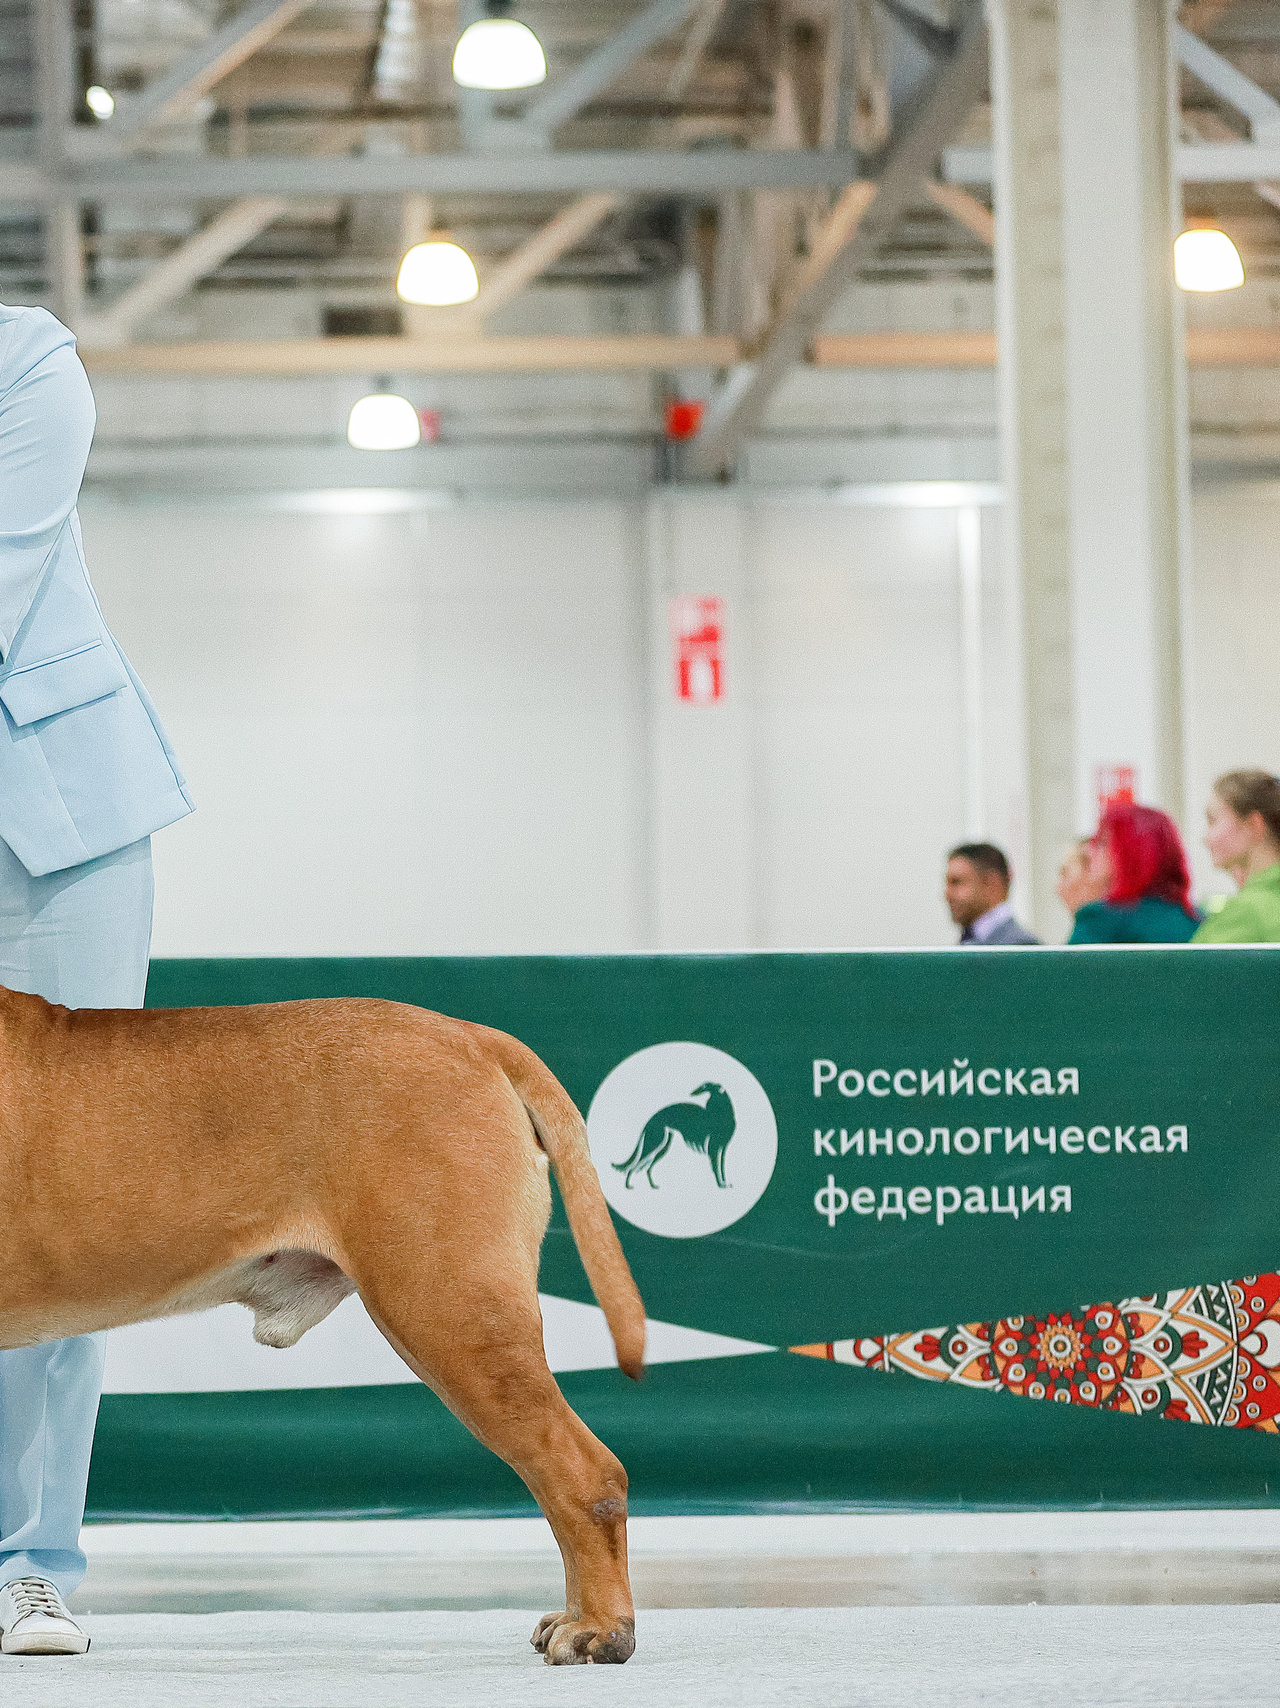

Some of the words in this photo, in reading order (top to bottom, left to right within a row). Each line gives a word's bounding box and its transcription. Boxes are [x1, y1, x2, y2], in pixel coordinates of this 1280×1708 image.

[812, 1058, 1080, 1098] Российская
[813, 1125, 1189, 1156] кинологическая
[813, 1173, 1073, 1228] федерация
